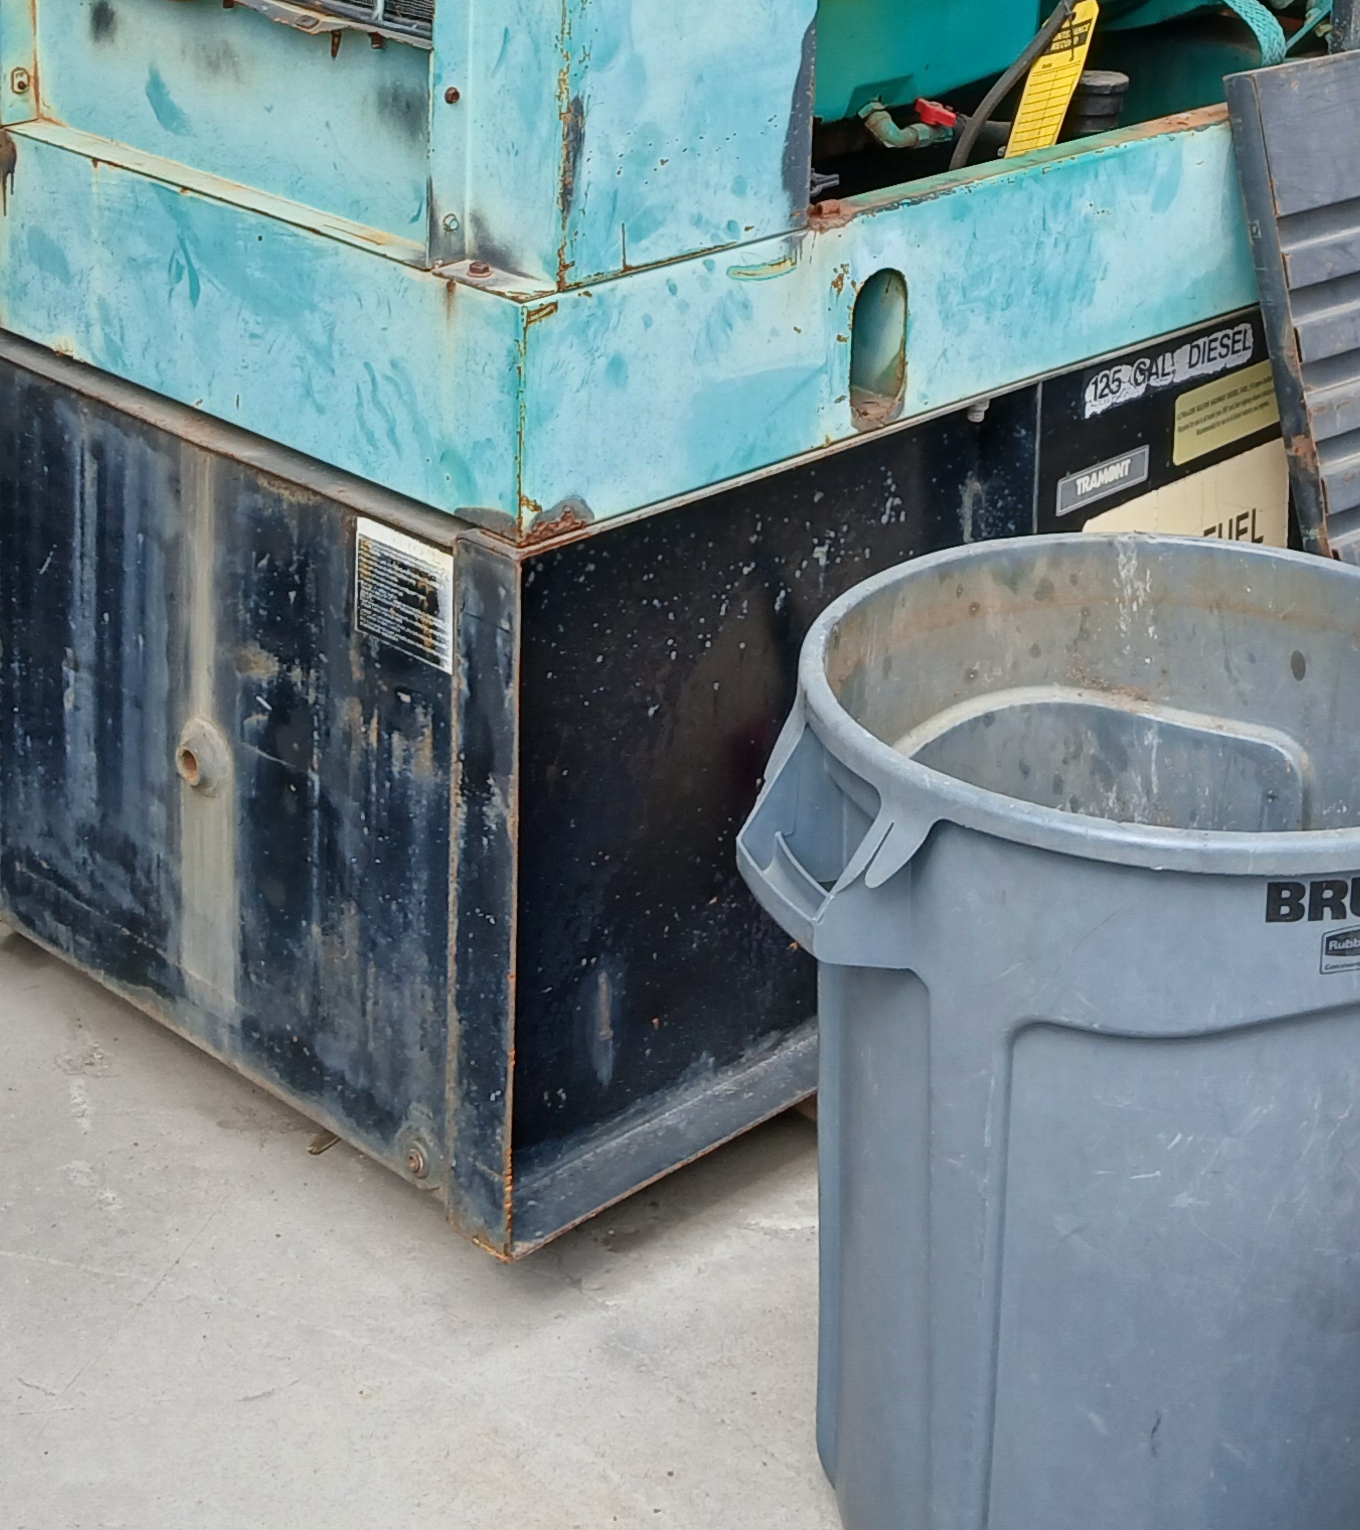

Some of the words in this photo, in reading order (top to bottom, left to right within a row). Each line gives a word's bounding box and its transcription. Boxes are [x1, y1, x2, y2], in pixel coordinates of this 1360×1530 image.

[1089, 367, 1123, 402] 125
[1188, 328, 1253, 370] DIESEL
[1075, 459, 1131, 497] TRAMONT
